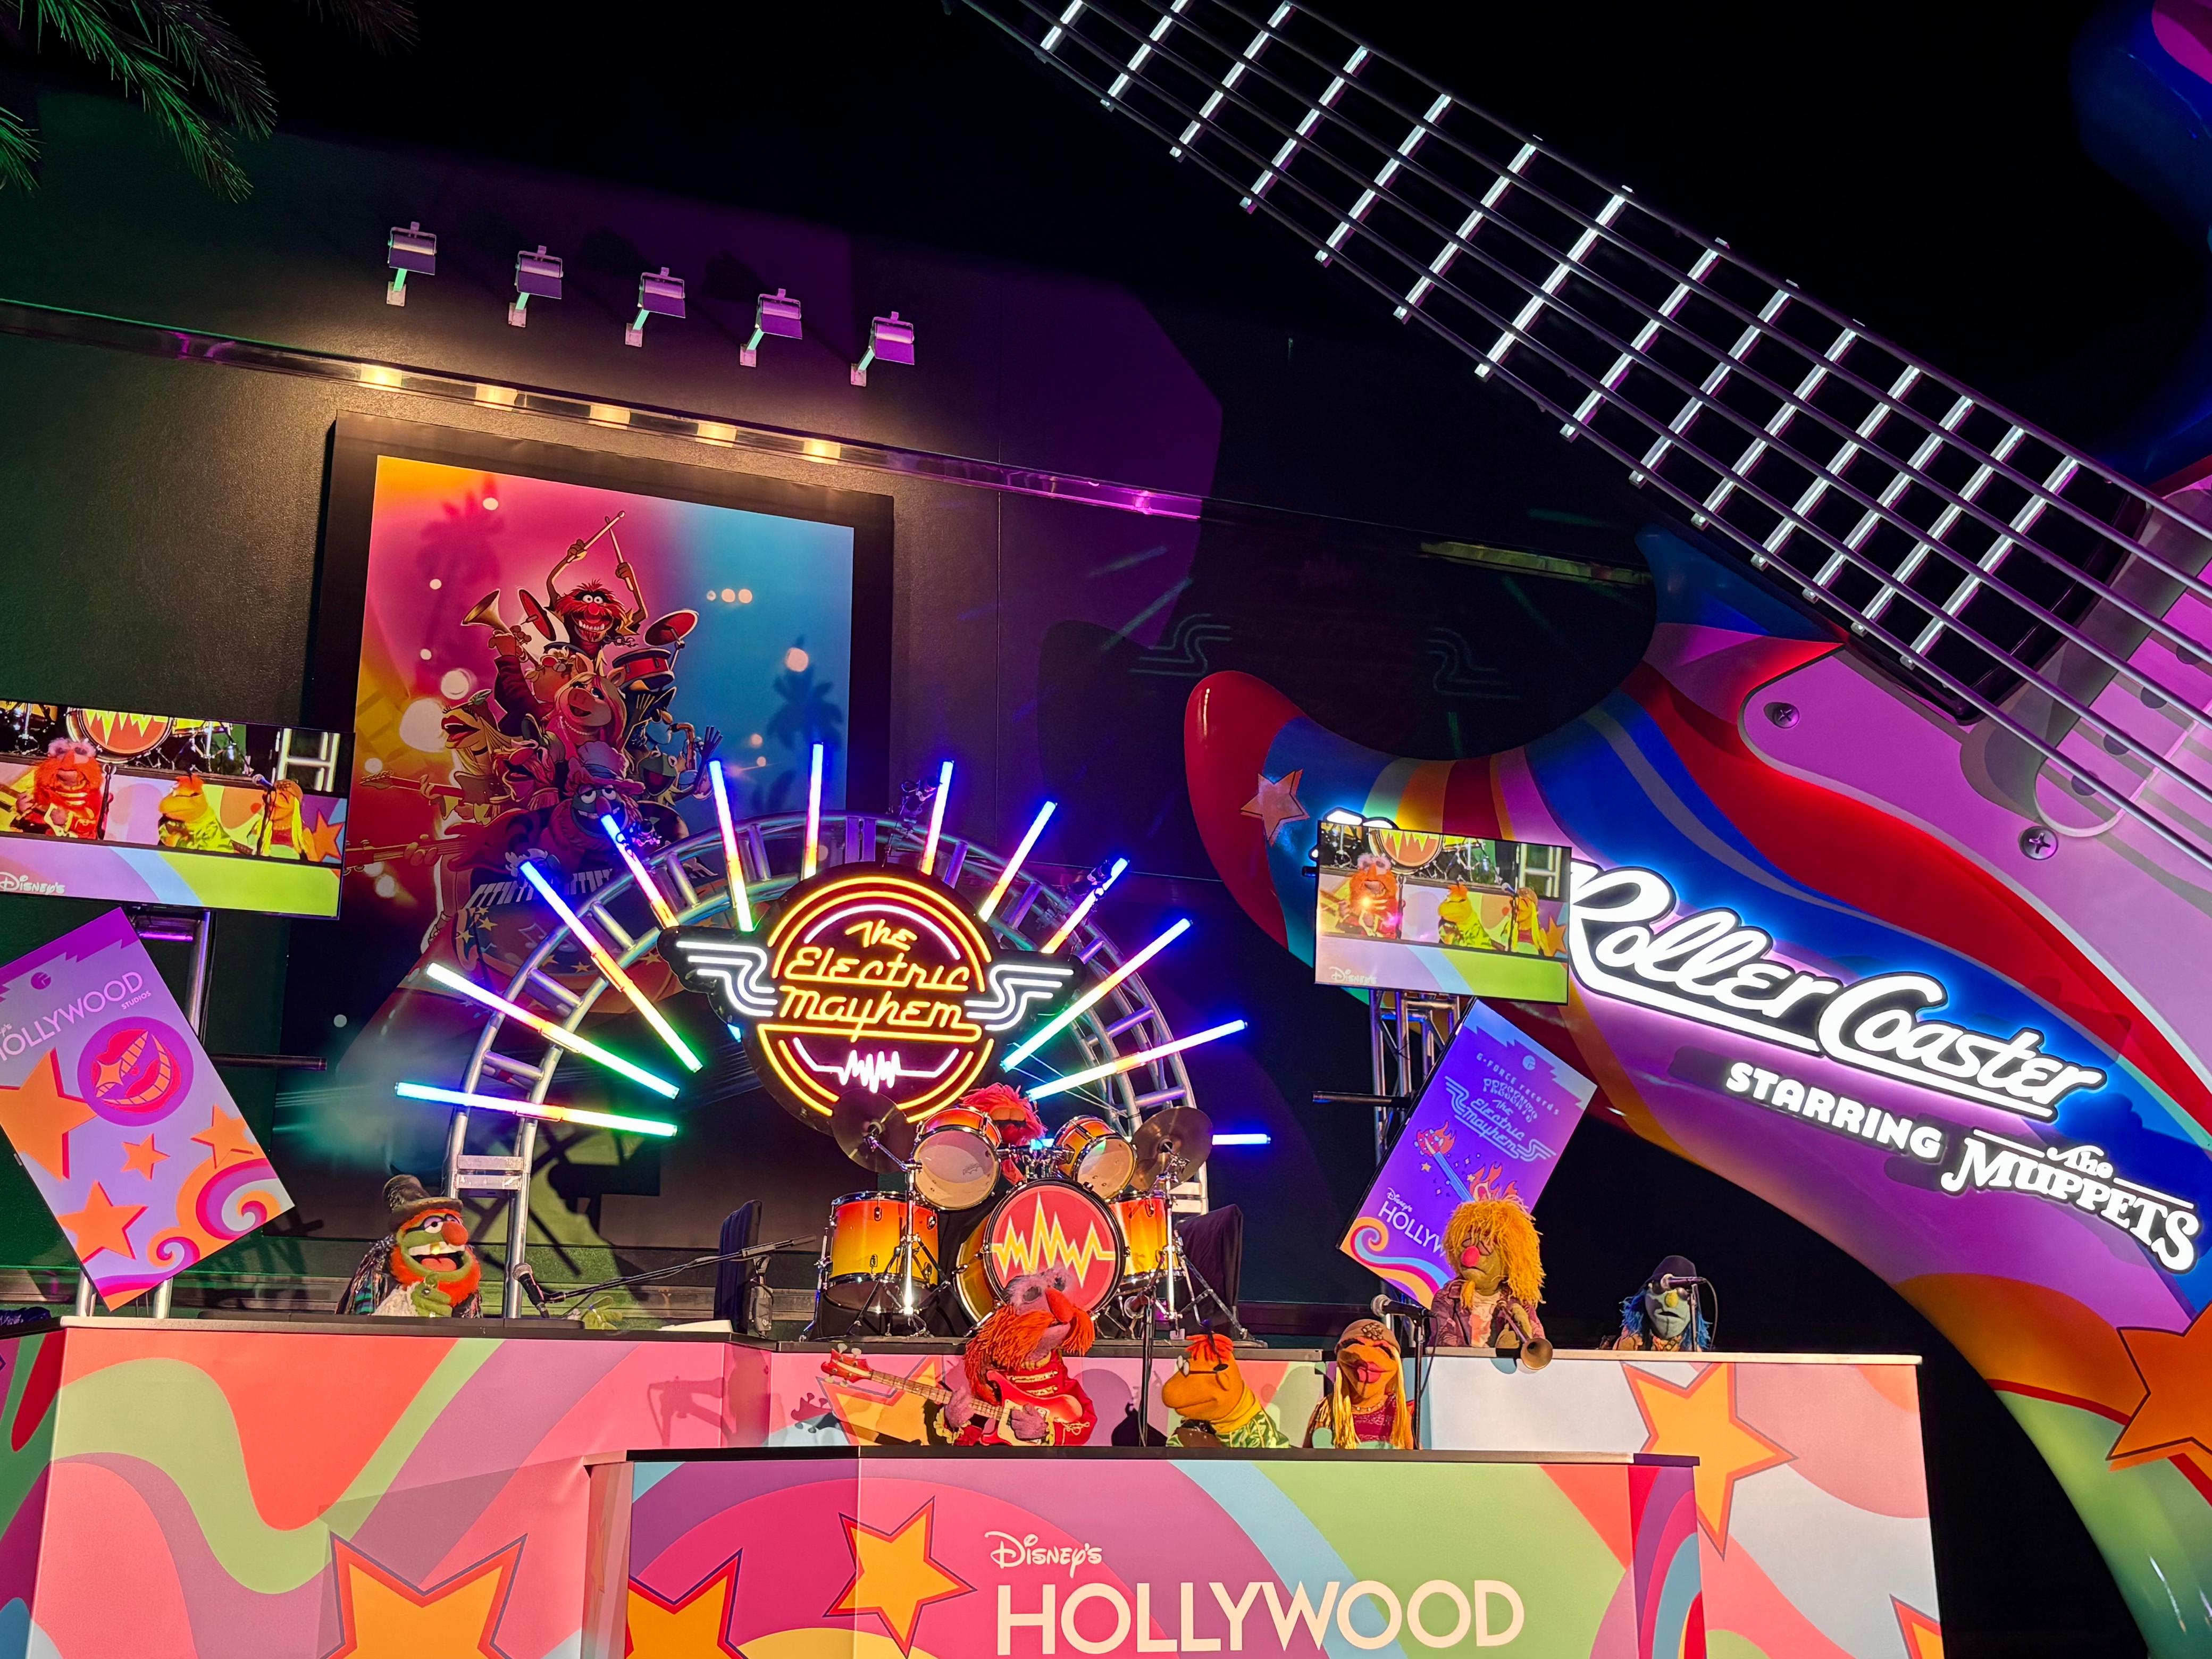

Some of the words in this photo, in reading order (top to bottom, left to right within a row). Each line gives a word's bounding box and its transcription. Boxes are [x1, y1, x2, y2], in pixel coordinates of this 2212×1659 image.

[845, 919, 918, 951] The
[784, 946, 970, 992] Electric
[1570, 861, 1840, 1051] Roller
[1819, 976, 2104, 1117] Coaster
[121, 990, 152, 1010] STUDIOS
[779, 985, 965, 1043] Mayhem
[1470, 1098, 1525, 1141] Electric
[1483, 1078, 1538, 1123] PRESENTS
[1492, 1099, 1514, 1116] The
[1519, 1084, 1560, 1115] records
[1726, 1062, 1943, 1159] STARRING
[1461, 1106, 1517, 1154] Mayhem
[2046, 1145, 2114, 1179] The
[1940, 1137, 2199, 1271] MUPPETS
[1378, 1201, 1446, 1258] HOLLYW
[984, 1531, 1103, 1578] Disney's
[996, 1580, 1524, 1656] HOLLYWOOD
